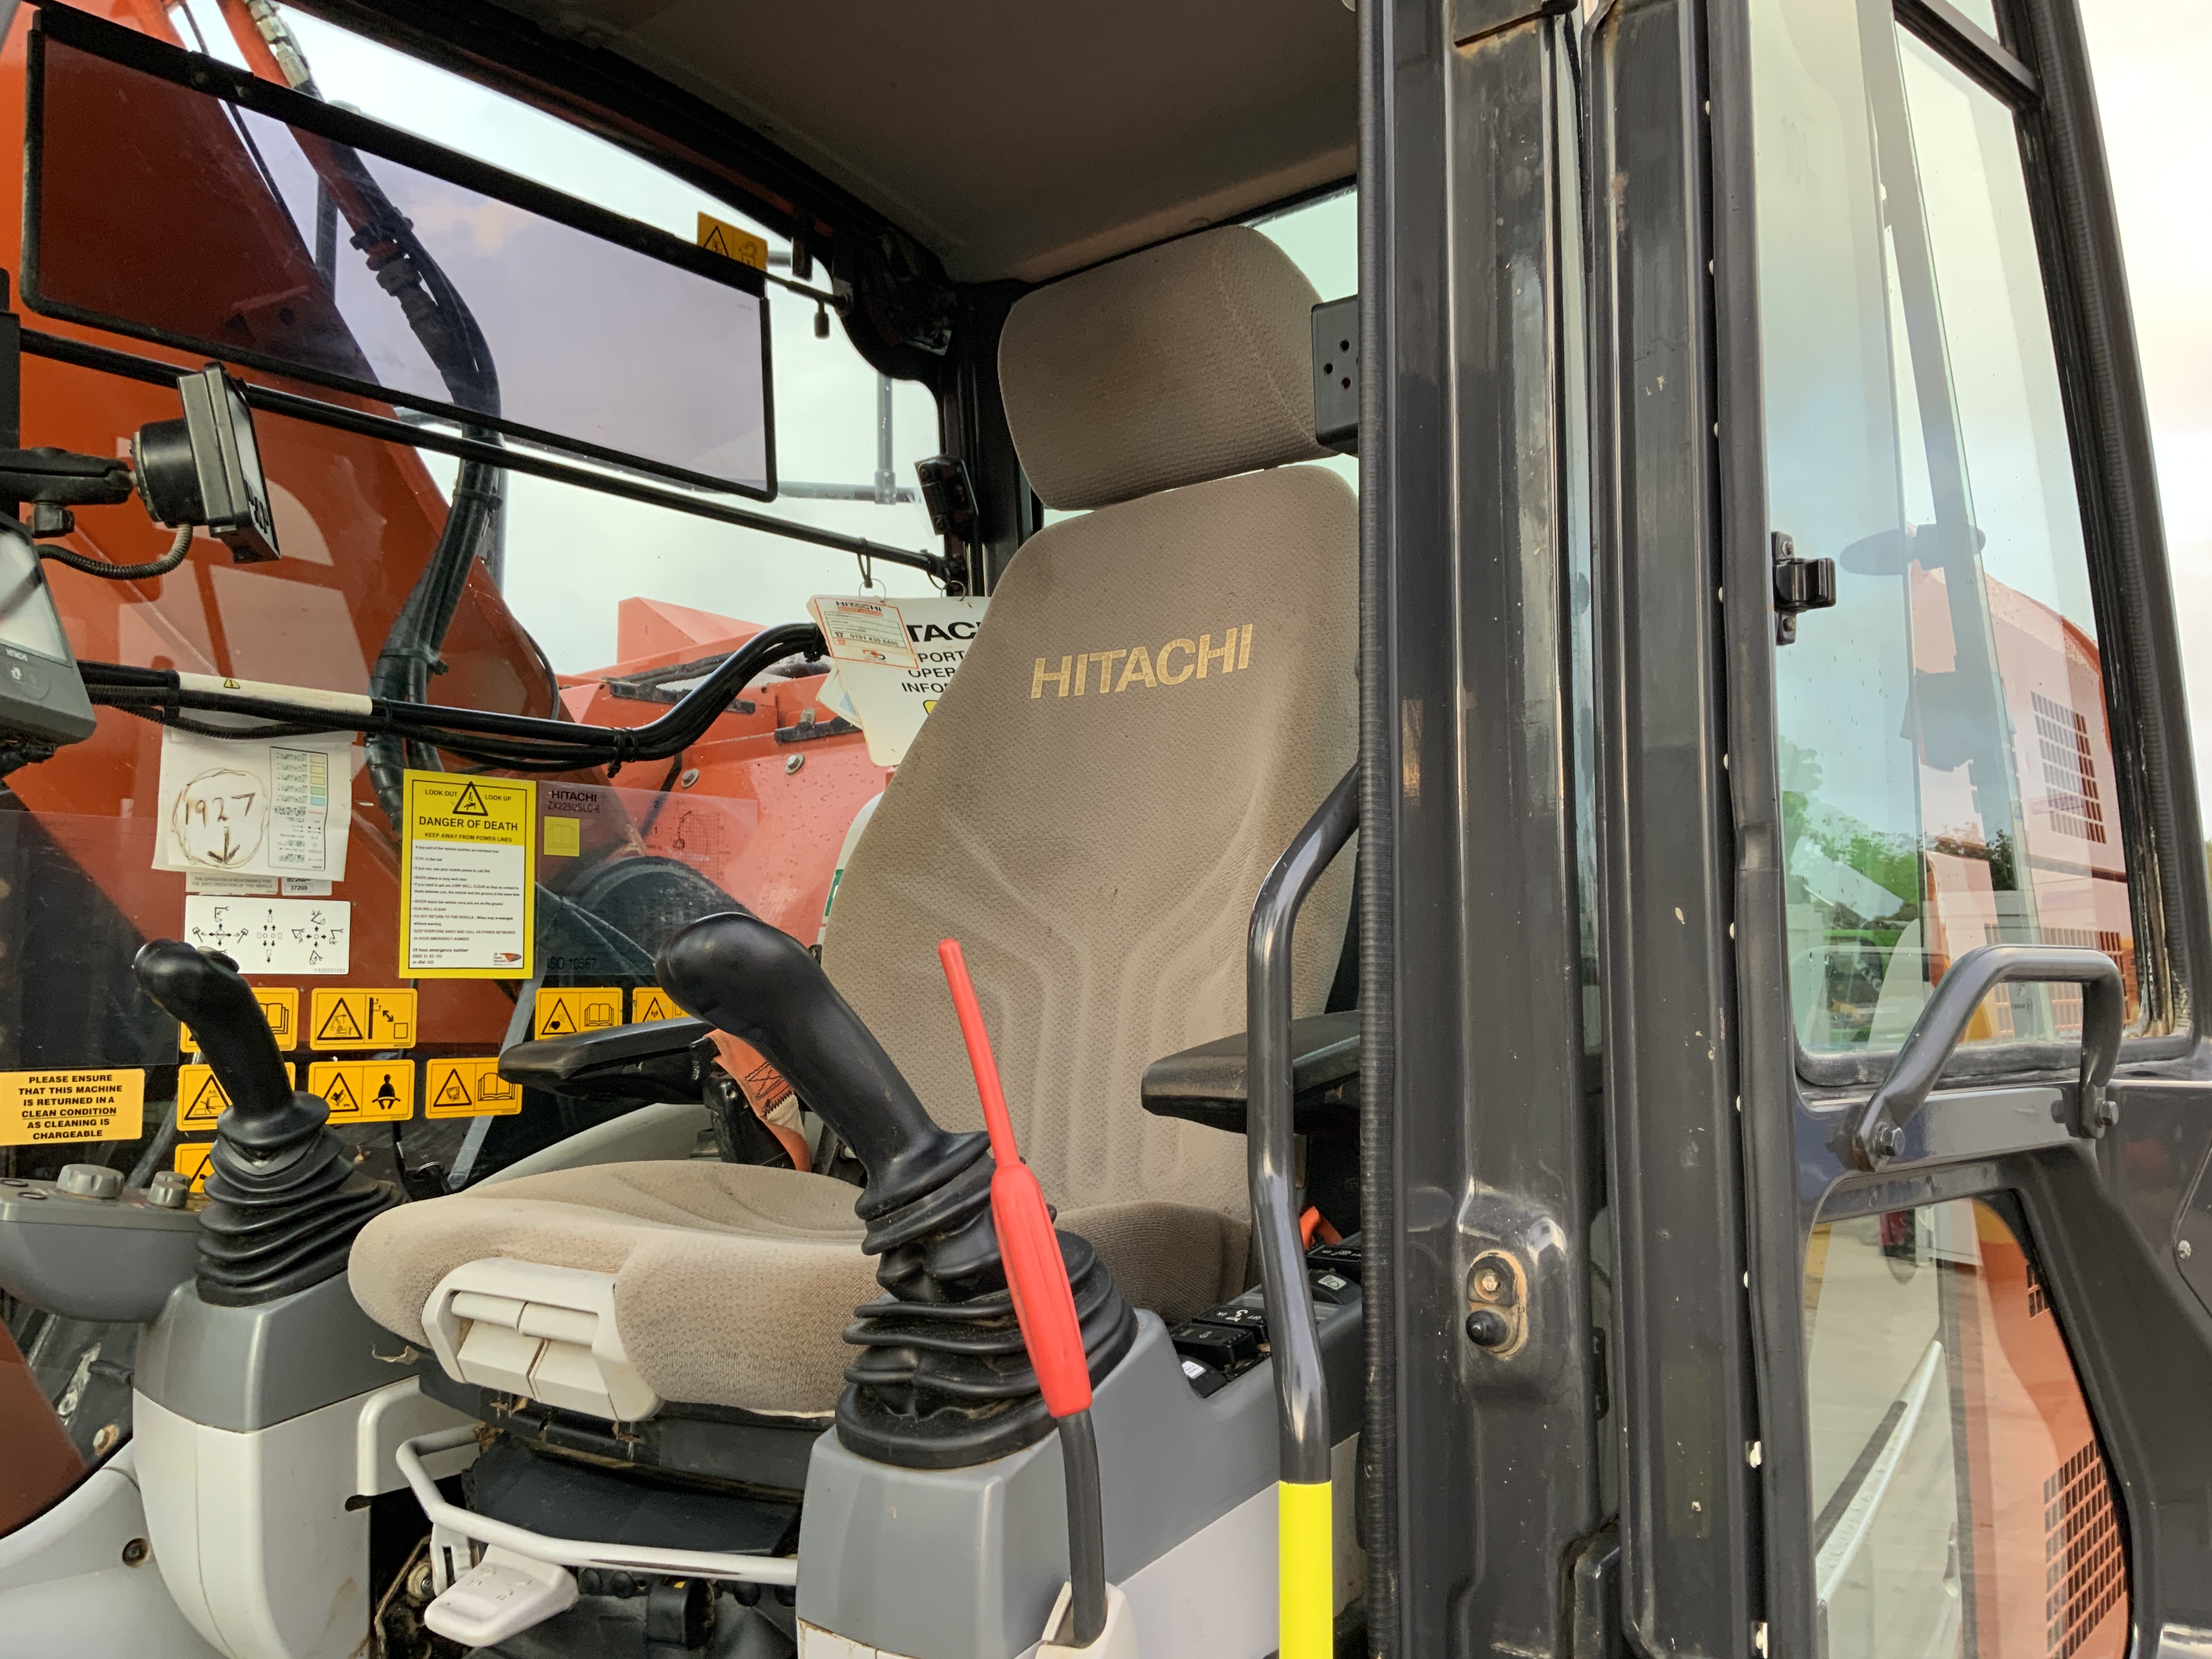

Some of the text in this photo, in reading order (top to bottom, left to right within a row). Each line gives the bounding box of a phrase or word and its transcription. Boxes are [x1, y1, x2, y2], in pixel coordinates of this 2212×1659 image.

[1030, 623, 1253, 699] HITACHI
[551, 790, 597, 802] HITACHI
[185, 792, 256, 828] 1927
[419, 816, 518, 831] DANGER OF DEATH
[548, 957, 564, 969] ISO
[37, 1097, 92, 1105] RETURNED
[22, 1107, 116, 1118] CLEAN CONDITION
[44, 1119, 97, 1128] CLEANING
[33, 1130, 103, 1140] CHARGEABLE
